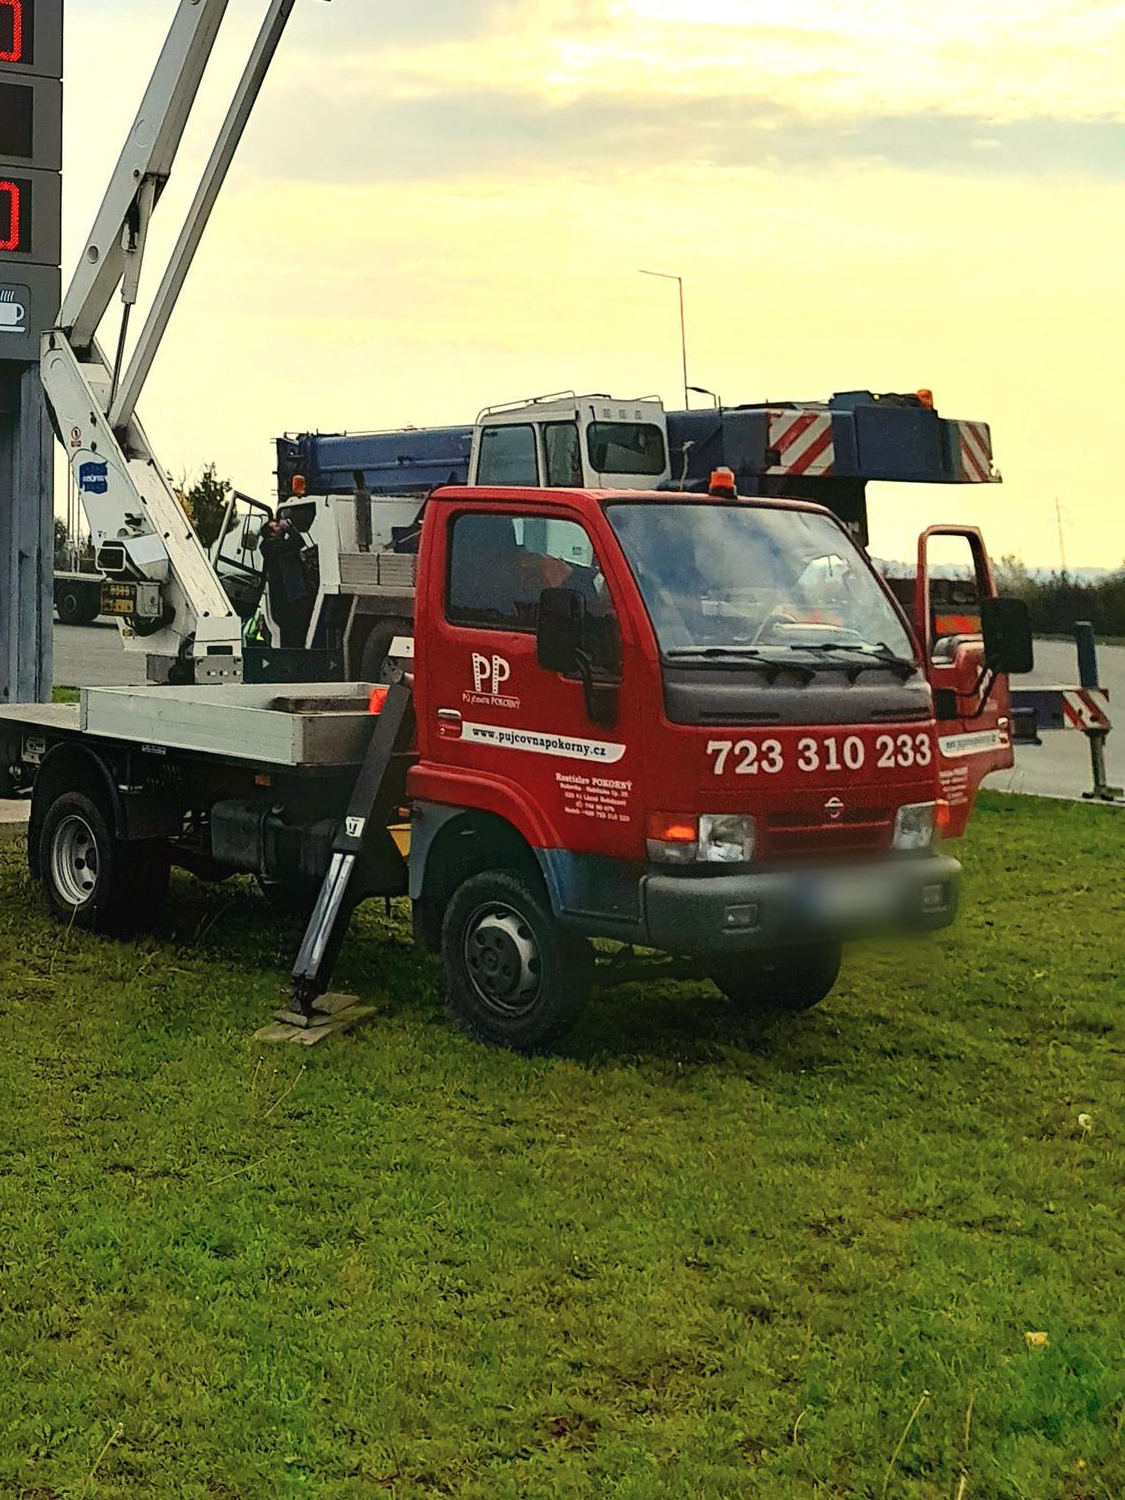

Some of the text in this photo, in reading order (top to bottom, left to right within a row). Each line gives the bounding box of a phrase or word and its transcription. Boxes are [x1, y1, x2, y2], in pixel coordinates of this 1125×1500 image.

[471, 652, 511, 695] PP
[472, 726, 607, 757] www.pujcovnapokorny.cz
[706, 738, 785, 776] 723
[796, 736, 866, 772] 310
[875, 732, 933, 768] 233
